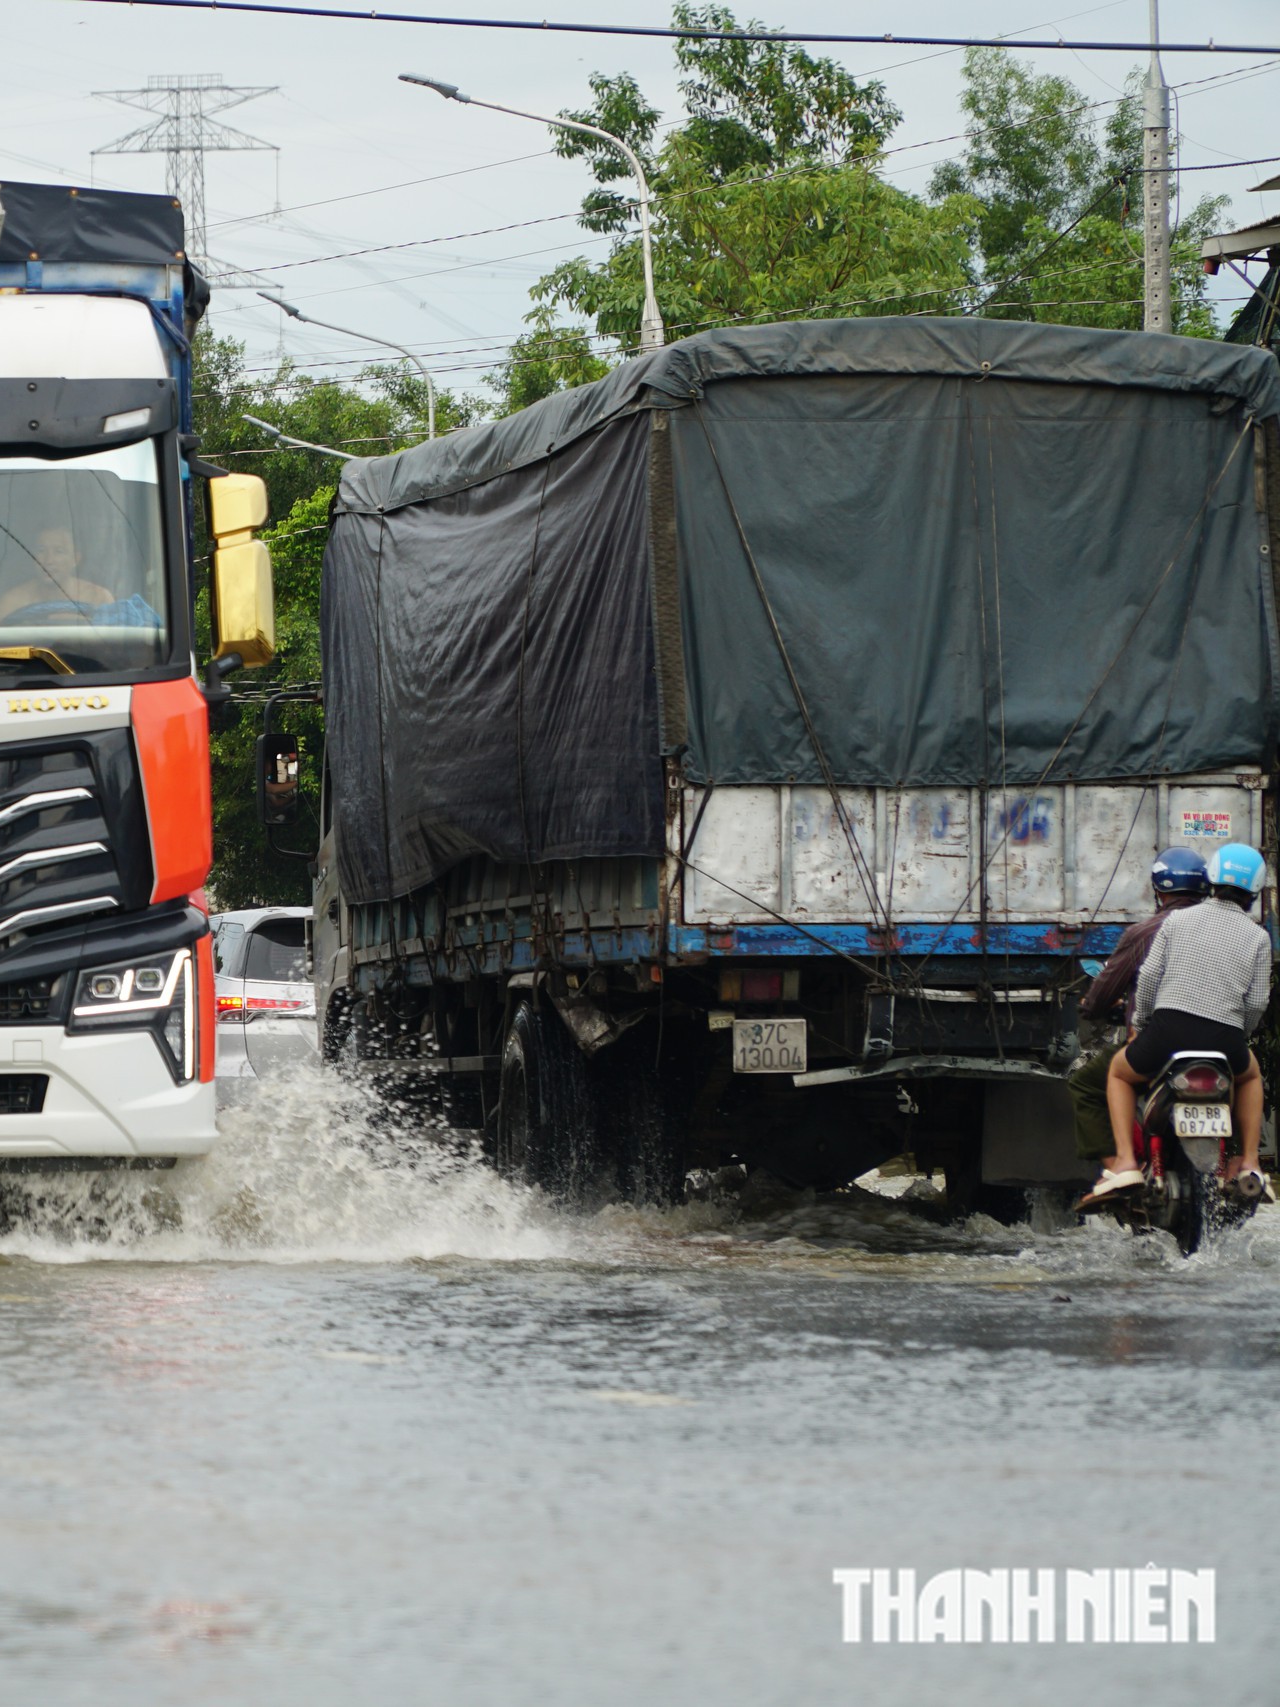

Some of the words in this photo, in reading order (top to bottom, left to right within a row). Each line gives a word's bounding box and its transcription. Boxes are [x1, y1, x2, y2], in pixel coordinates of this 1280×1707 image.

[7, 695, 110, 713] HOWO
[751, 1024, 787, 1045] 37C
[740, 1047, 803, 1069] 130.04
[1180, 1121, 1227, 1133] 087.44
